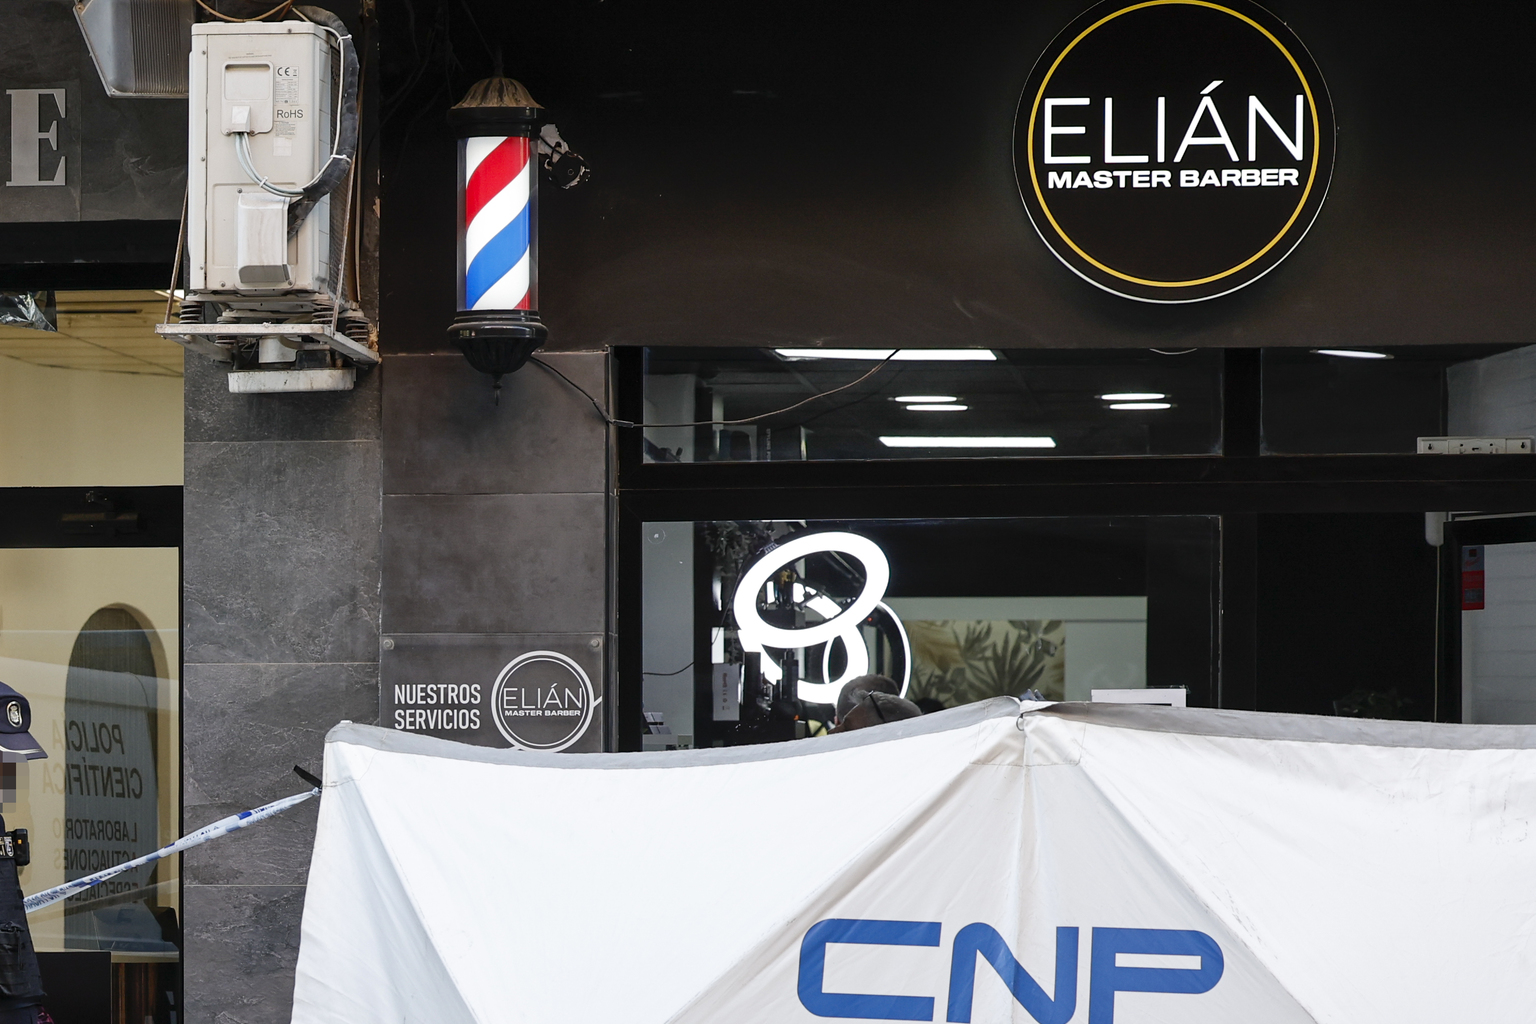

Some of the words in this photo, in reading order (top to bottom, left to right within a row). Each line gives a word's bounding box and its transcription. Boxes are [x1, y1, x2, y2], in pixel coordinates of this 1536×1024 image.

[276, 109, 304, 119] RoHS
[1043, 79, 1305, 165] ELIÁN
[1047, 170, 1172, 189] MASTER
[1179, 168, 1300, 188] BARBER
[394, 684, 481, 705] NUESTROS
[503, 683, 582, 709] ELIÁN
[394, 709, 481, 730] SERVICIOS
